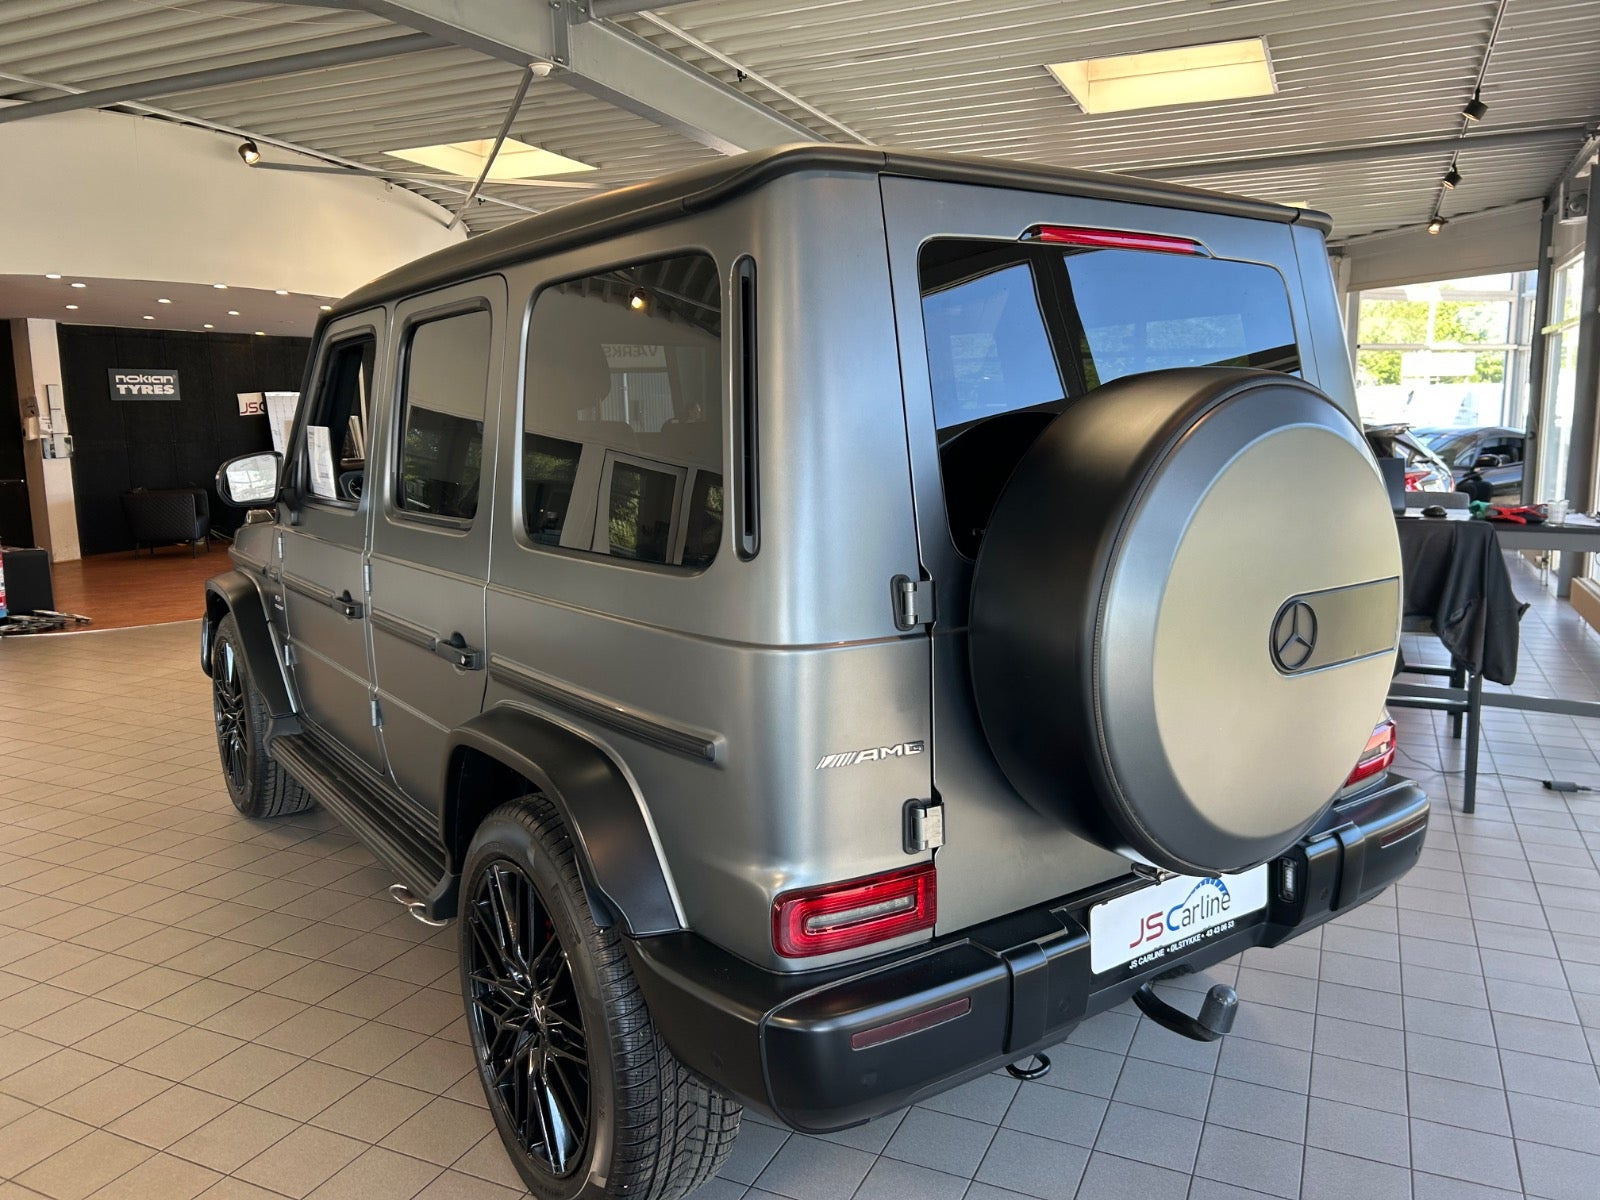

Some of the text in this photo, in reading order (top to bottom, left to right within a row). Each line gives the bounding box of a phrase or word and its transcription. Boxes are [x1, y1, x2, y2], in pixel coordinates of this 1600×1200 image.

[115, 374, 174, 383] nokian
[116, 384, 175, 395] TYRES
[854, 740, 924, 764] AMG
[1129, 959, 1138, 969] JS
[1138, 948, 1165, 966] CARLINE
[1205, 928, 1213, 937] 43
[1213, 926, 1221, 934] 43
